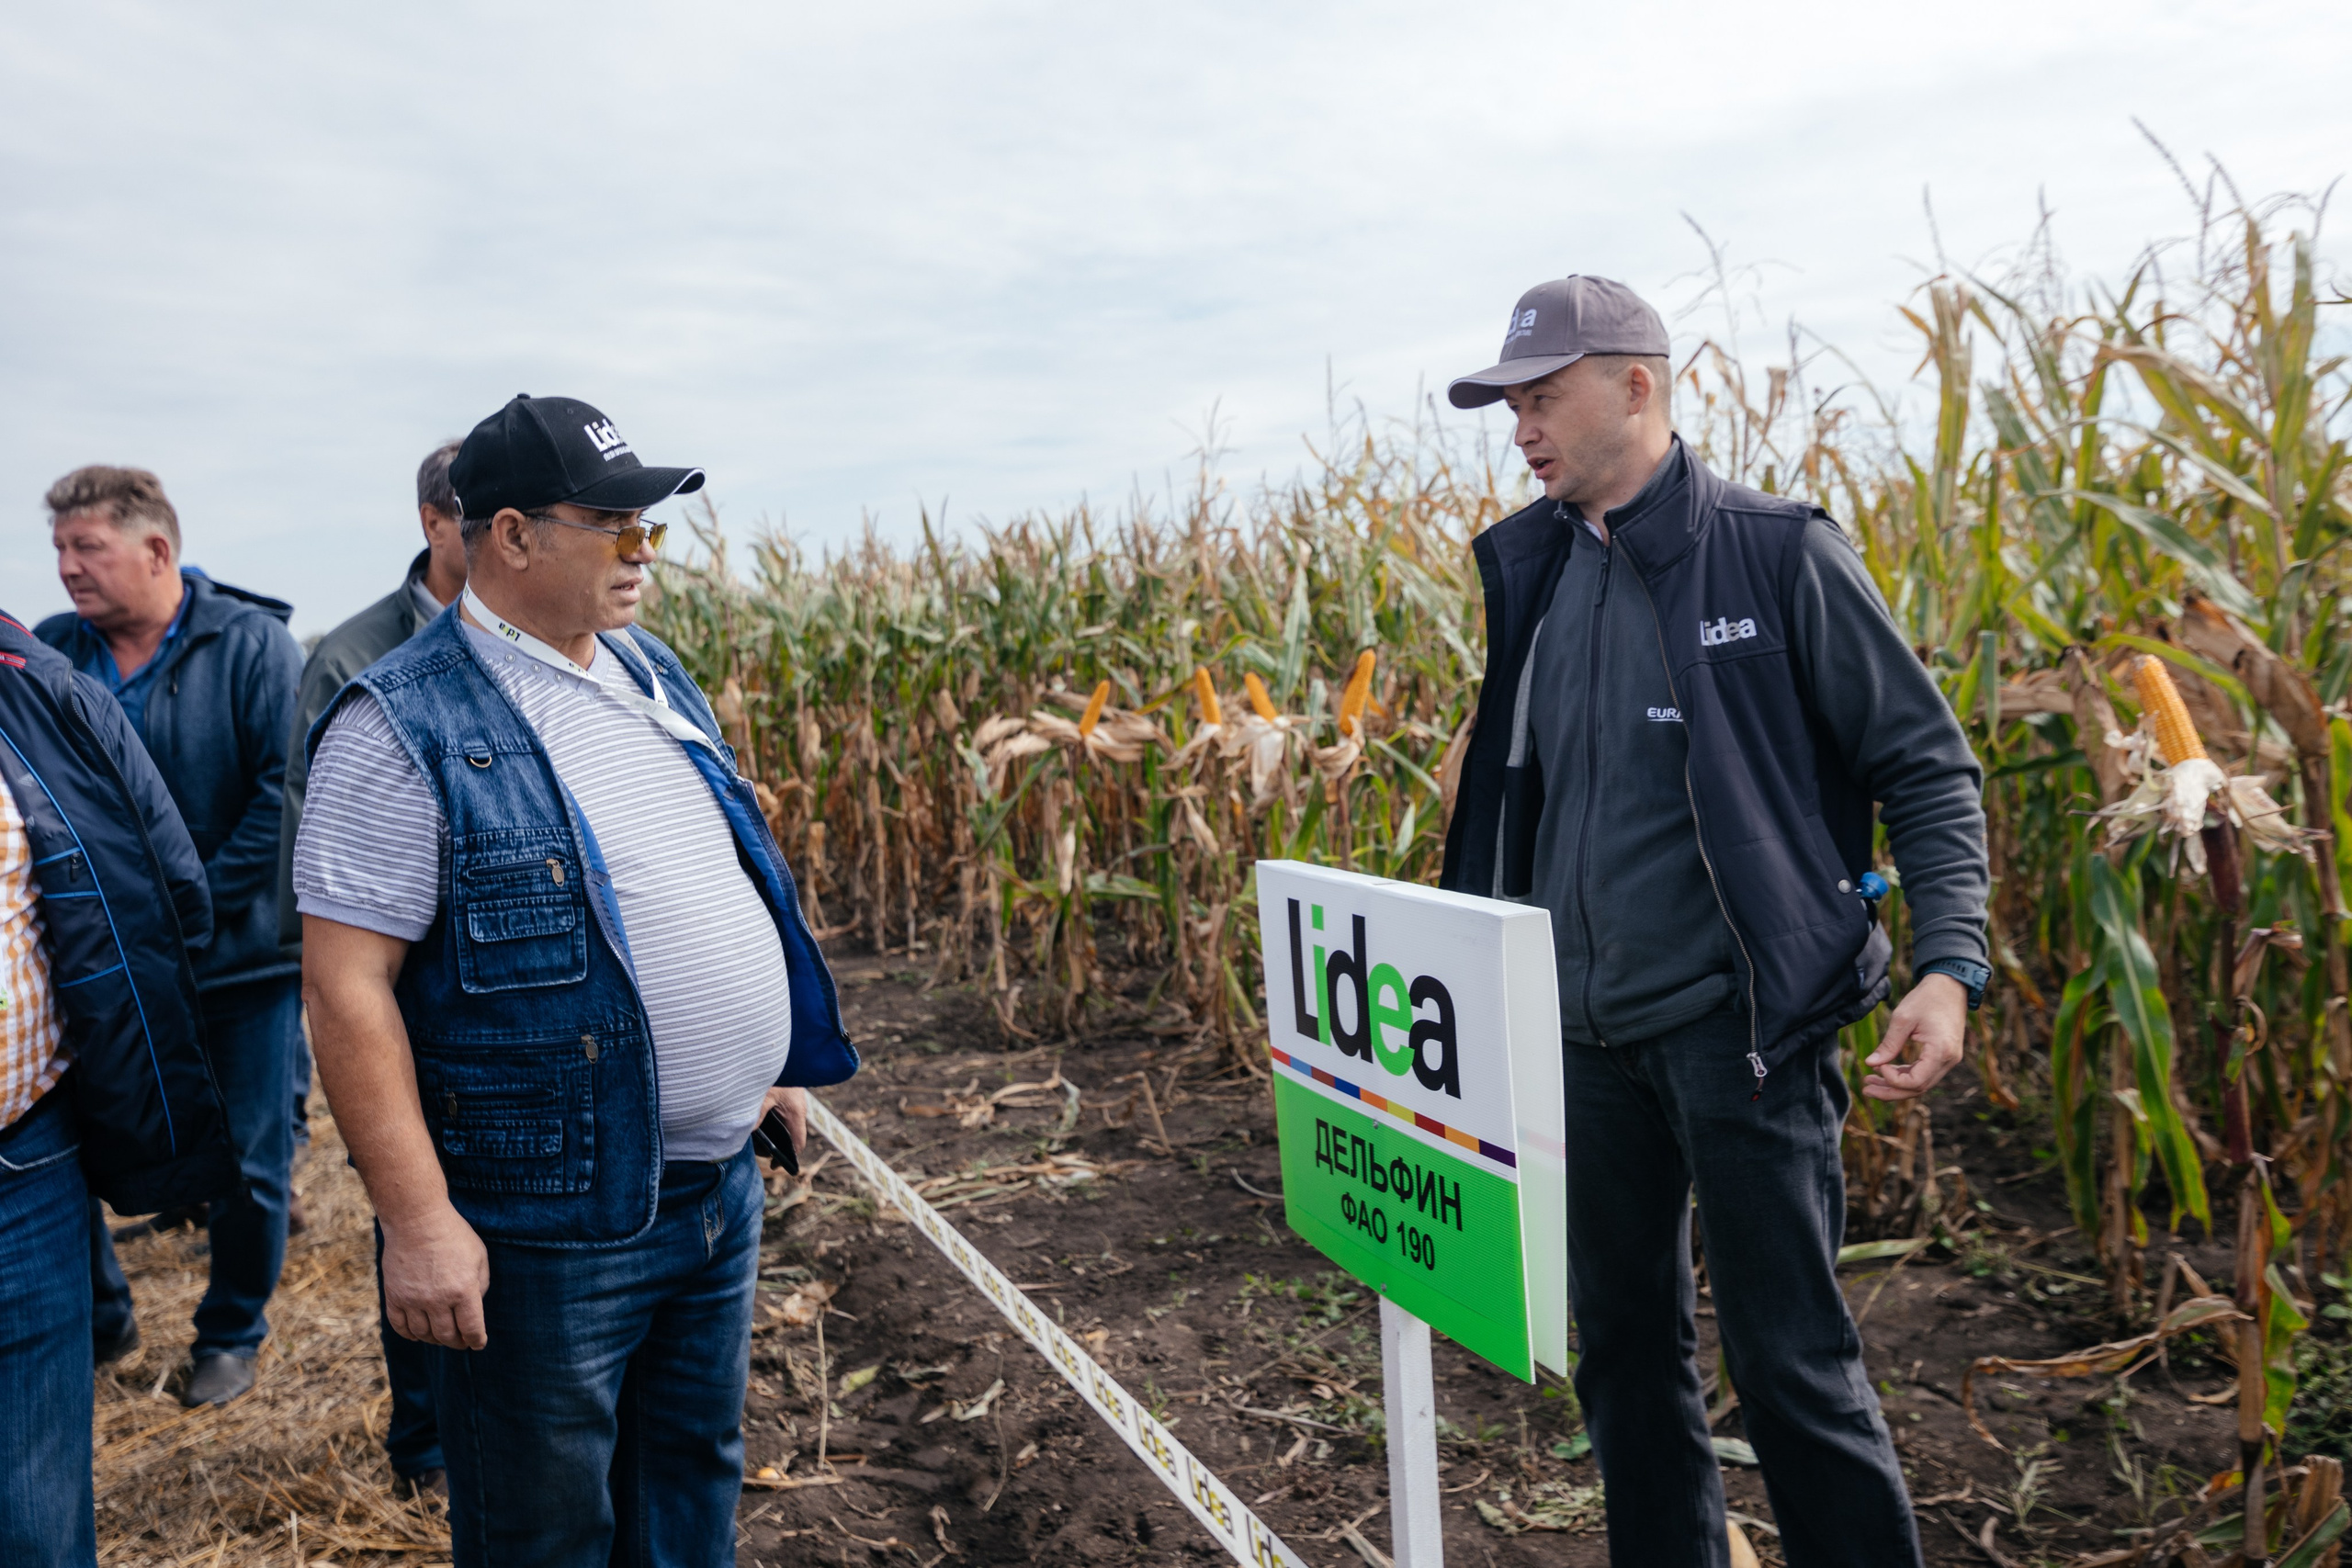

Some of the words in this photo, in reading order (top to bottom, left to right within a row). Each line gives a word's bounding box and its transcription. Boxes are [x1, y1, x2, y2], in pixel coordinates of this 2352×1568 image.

[1700, 616, 1757, 646] Lidea
[1287, 897, 1462, 1100] Lidea
[1316, 1118, 1463, 1232] ДЕЛЬФИН
[1341, 1192, 1387, 1245] ФАО
[1396, 1221, 1435, 1271] 190
[1133, 1404, 1179, 1481] Lidea
[1186, 1455, 1236, 1540] Lidea
